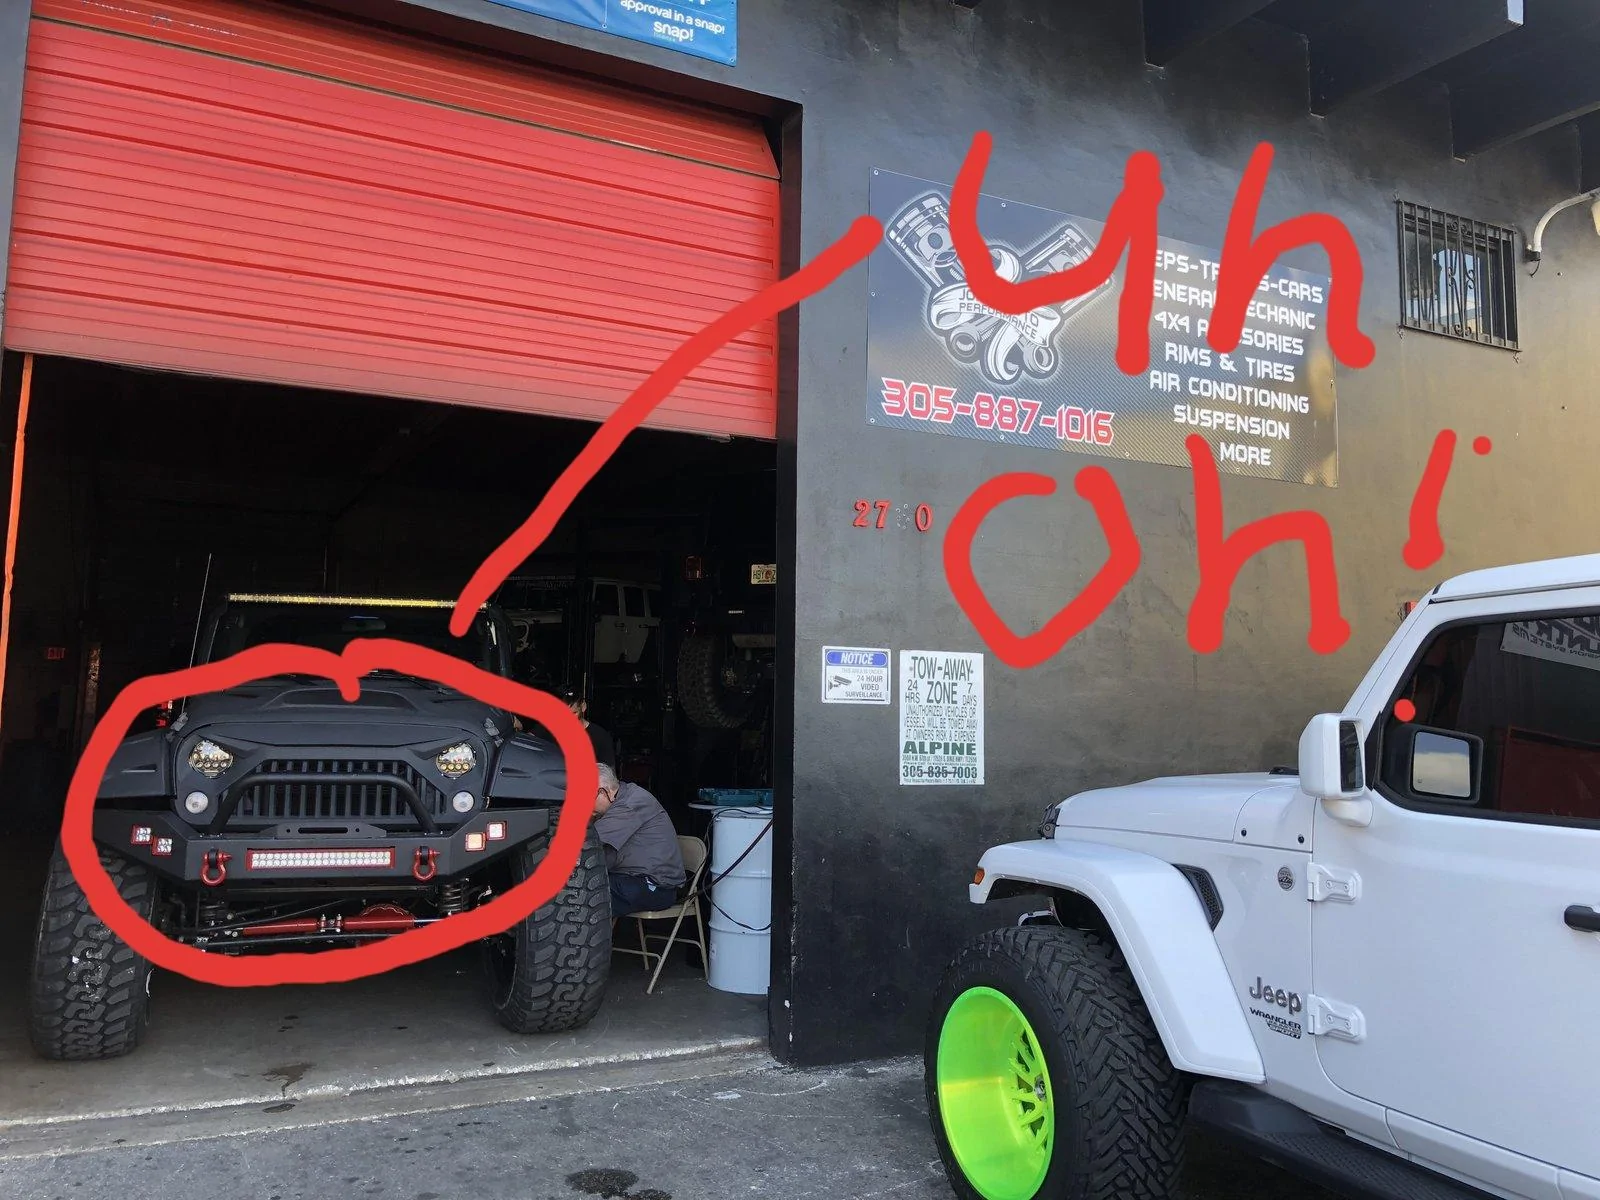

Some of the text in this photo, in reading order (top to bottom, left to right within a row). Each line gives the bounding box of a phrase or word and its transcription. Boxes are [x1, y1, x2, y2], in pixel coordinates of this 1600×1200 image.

[620, 0, 725, 35] approval in a snap!
[653, 20, 694, 42] snap!
[1152, 278, 1316, 330] ENERA ECHANIC
[1153, 310, 1304, 356] 4X4 ASORIES
[1165, 341, 1296, 383] RIMS & TIRES
[1149, 369, 1310, 414] AIR CONDITIONING
[881, 376, 1115, 445] 305-887-1016
[1173, 404, 1290, 441] SUSPENSION
[1219, 441, 1272, 467] MORE
[840, 651, 875, 665] NOTICE
[911, 656, 973, 682] TOW-AWAY
[857, 674, 884, 683] 24 HOUR
[860, 683, 880, 691] VIDEO
[907, 678, 918, 691] 24
[967, 682, 973, 694] 7
[904, 691, 920, 704] HRS
[926, 680, 958, 705] ZONE
[962, 694, 978, 707] DAYS
[902, 741, 977, 756] ALPINE
[1248, 975, 1303, 1016] Jeep
[1248, 1006, 1302, 1030] WRANGLER
